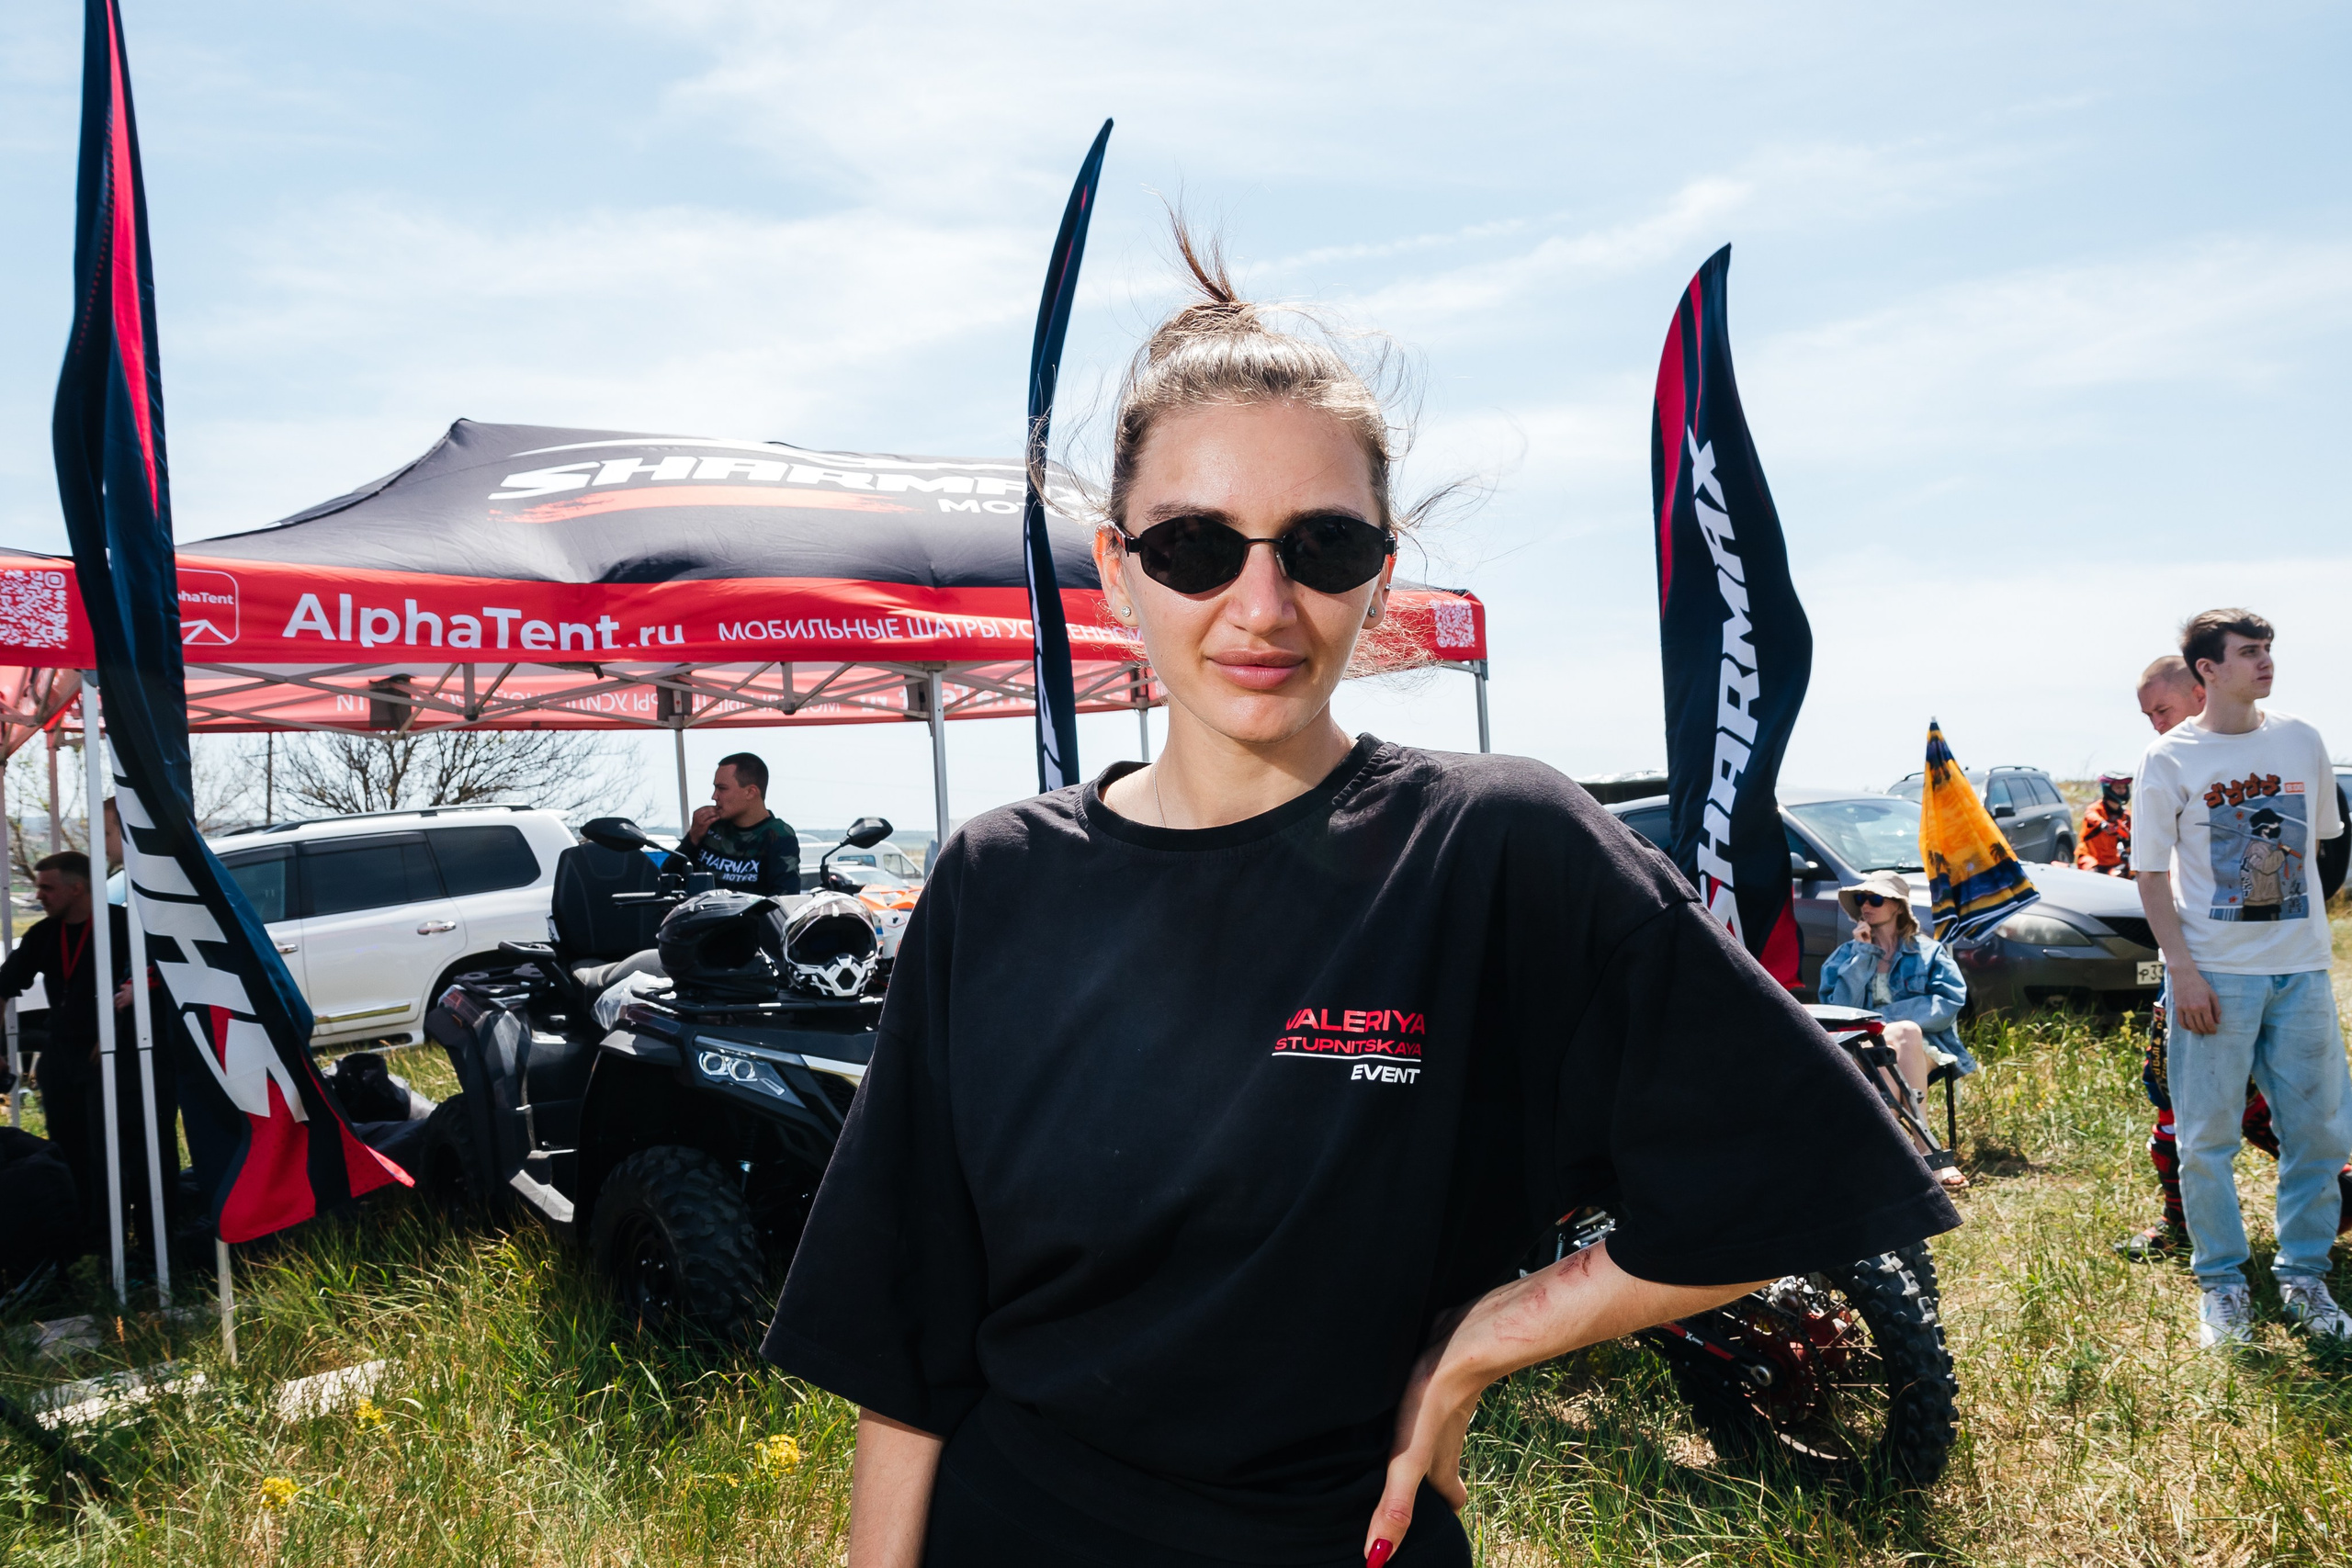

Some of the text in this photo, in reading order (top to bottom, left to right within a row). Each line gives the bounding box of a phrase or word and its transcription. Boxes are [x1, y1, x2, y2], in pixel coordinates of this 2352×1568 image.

[718, 617, 903, 641] МОБИЛЬНЫЕ
[907, 617, 1001, 638] ШАТРЫ
[1285, 1008, 1426, 1035] VALERIYA
[1274, 1036, 1422, 1056] STUPNITSKAYA
[1351, 1063, 1421, 1085] EVENT
